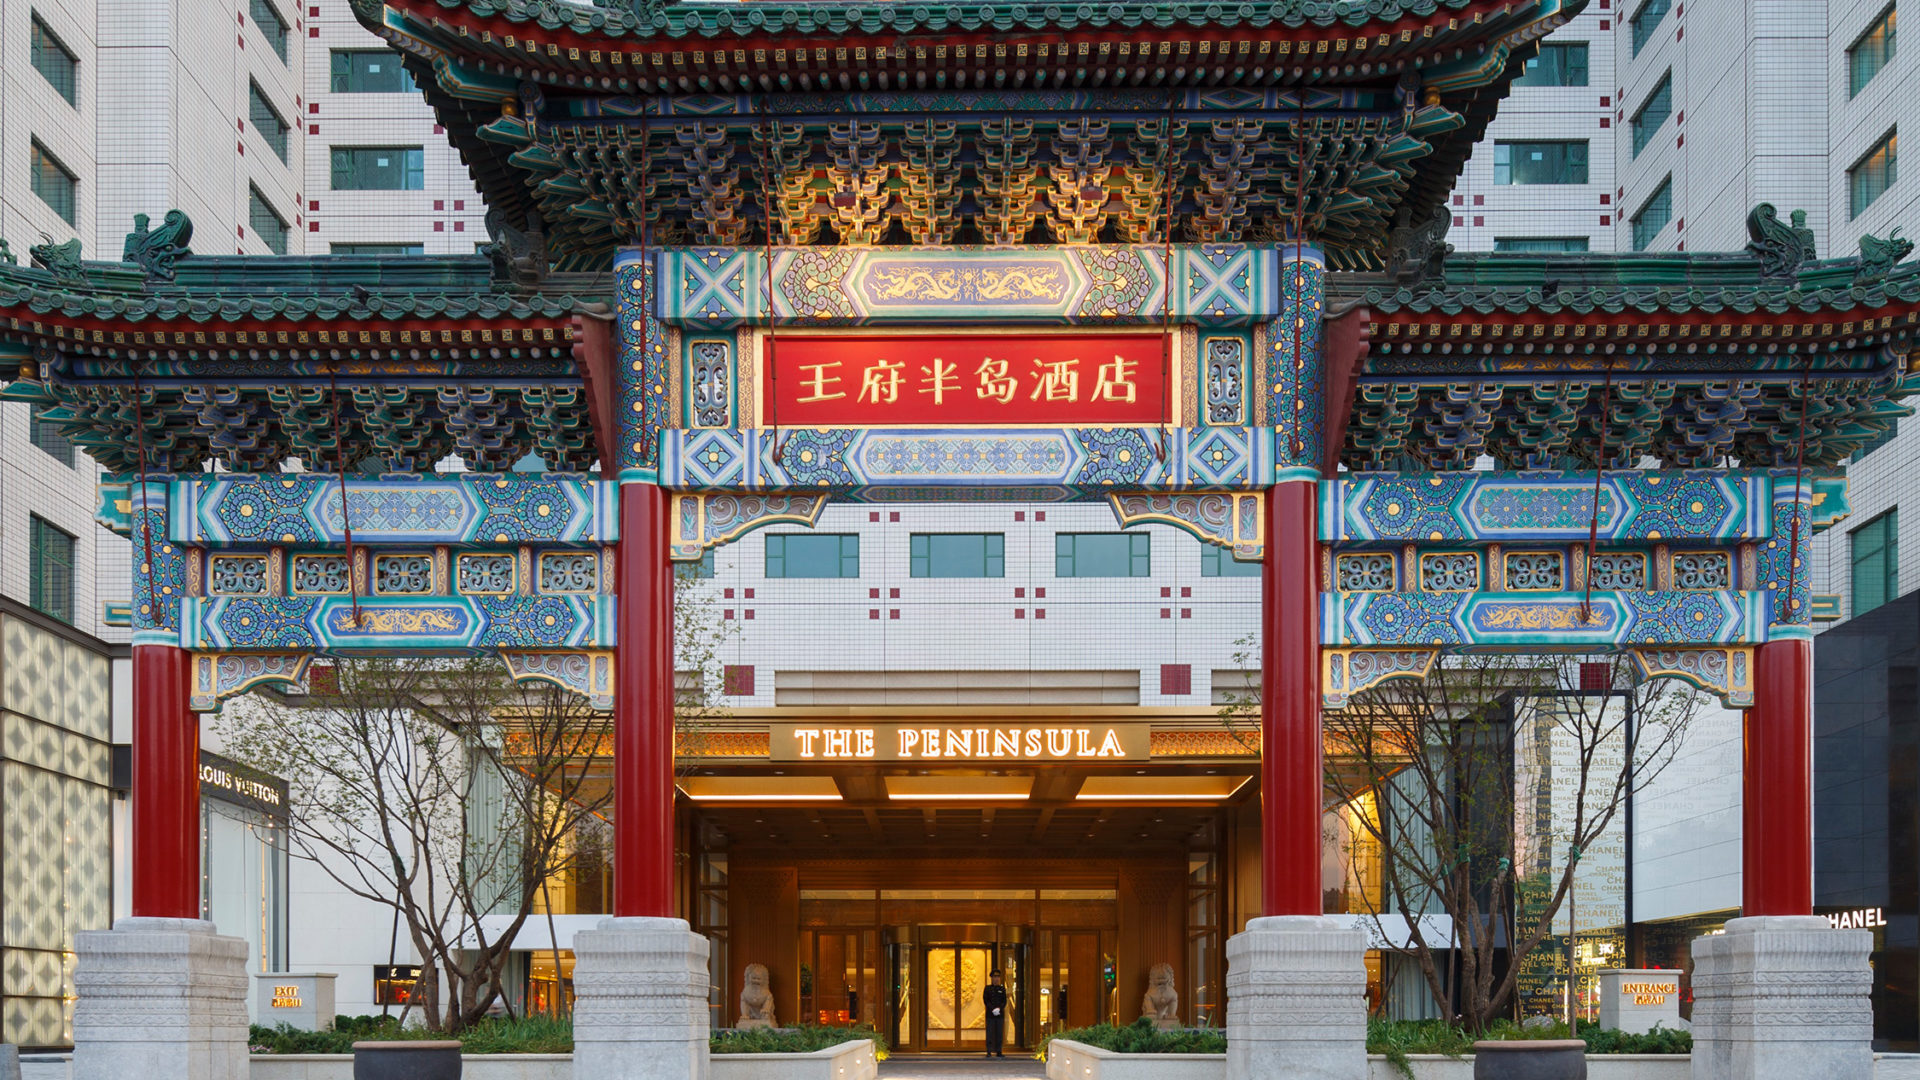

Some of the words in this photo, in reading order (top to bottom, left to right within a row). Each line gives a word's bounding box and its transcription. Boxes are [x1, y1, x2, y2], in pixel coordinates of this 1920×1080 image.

[796, 354, 1140, 405] 王府半岛酒店
[794, 728, 875, 758] THE
[897, 728, 1126, 758] PENINSULA
[1576, 757, 1621, 766] CANEL
[199, 763, 232, 790] LOUIS
[234, 776, 280, 807] VUITTON
[1571, 788, 1616, 796] CANEL
[1523, 953, 1568, 961] CHANEL
[274, 985, 299, 997] EXIT
[1535, 987, 1580, 995] CHANL
[1622, 983, 1677, 994] ENTRANCE
